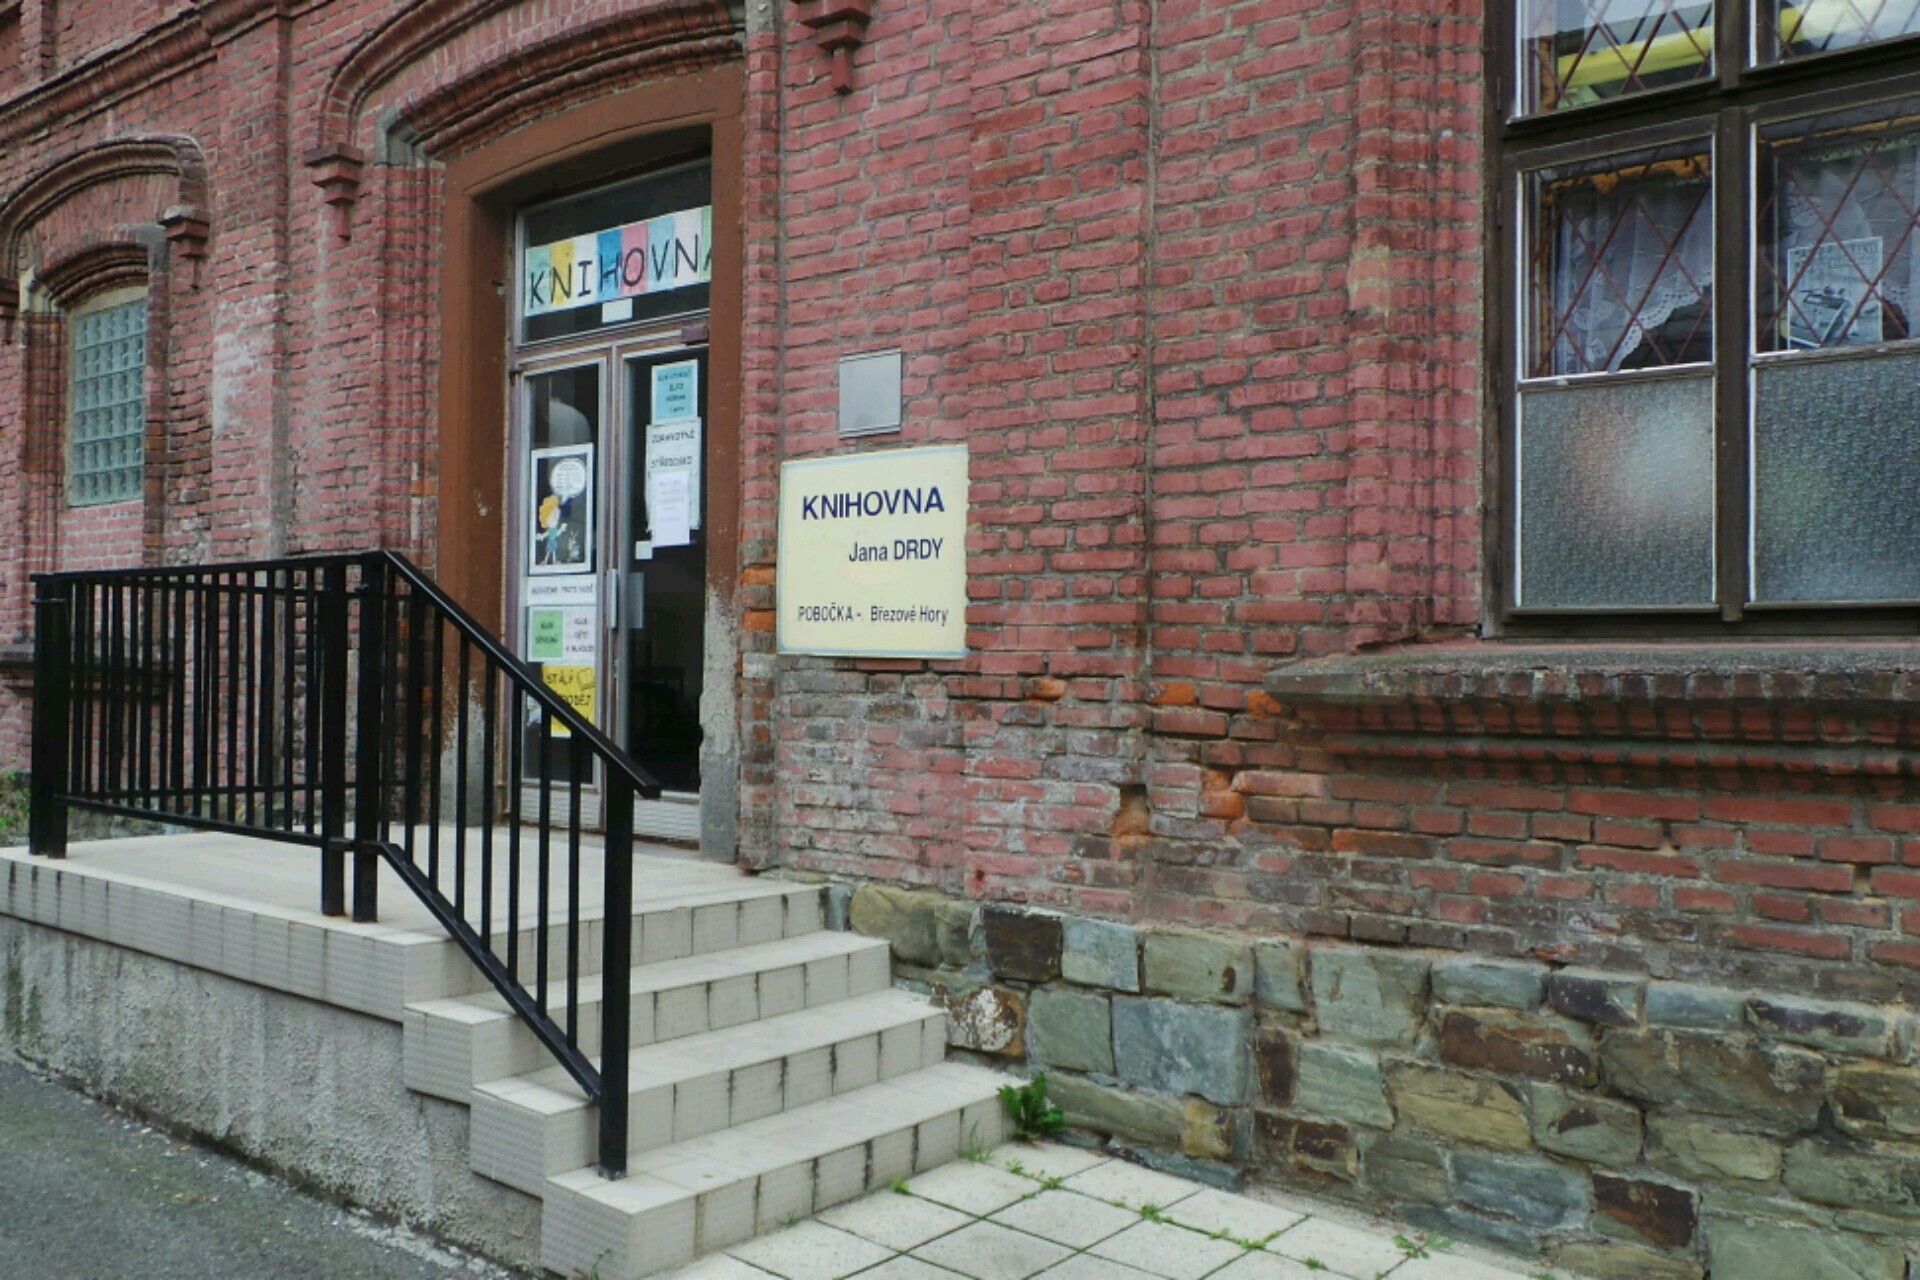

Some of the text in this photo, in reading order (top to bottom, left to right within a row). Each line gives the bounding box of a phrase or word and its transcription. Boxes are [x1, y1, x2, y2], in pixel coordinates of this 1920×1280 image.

[802, 486, 945, 520] KNIHOVNA
[849, 538, 944, 562] Jana DRDY
[798, 602, 854, 622] POBOČKA
[870, 605, 917, 623] Březové
[919, 606, 949, 627] Hory
